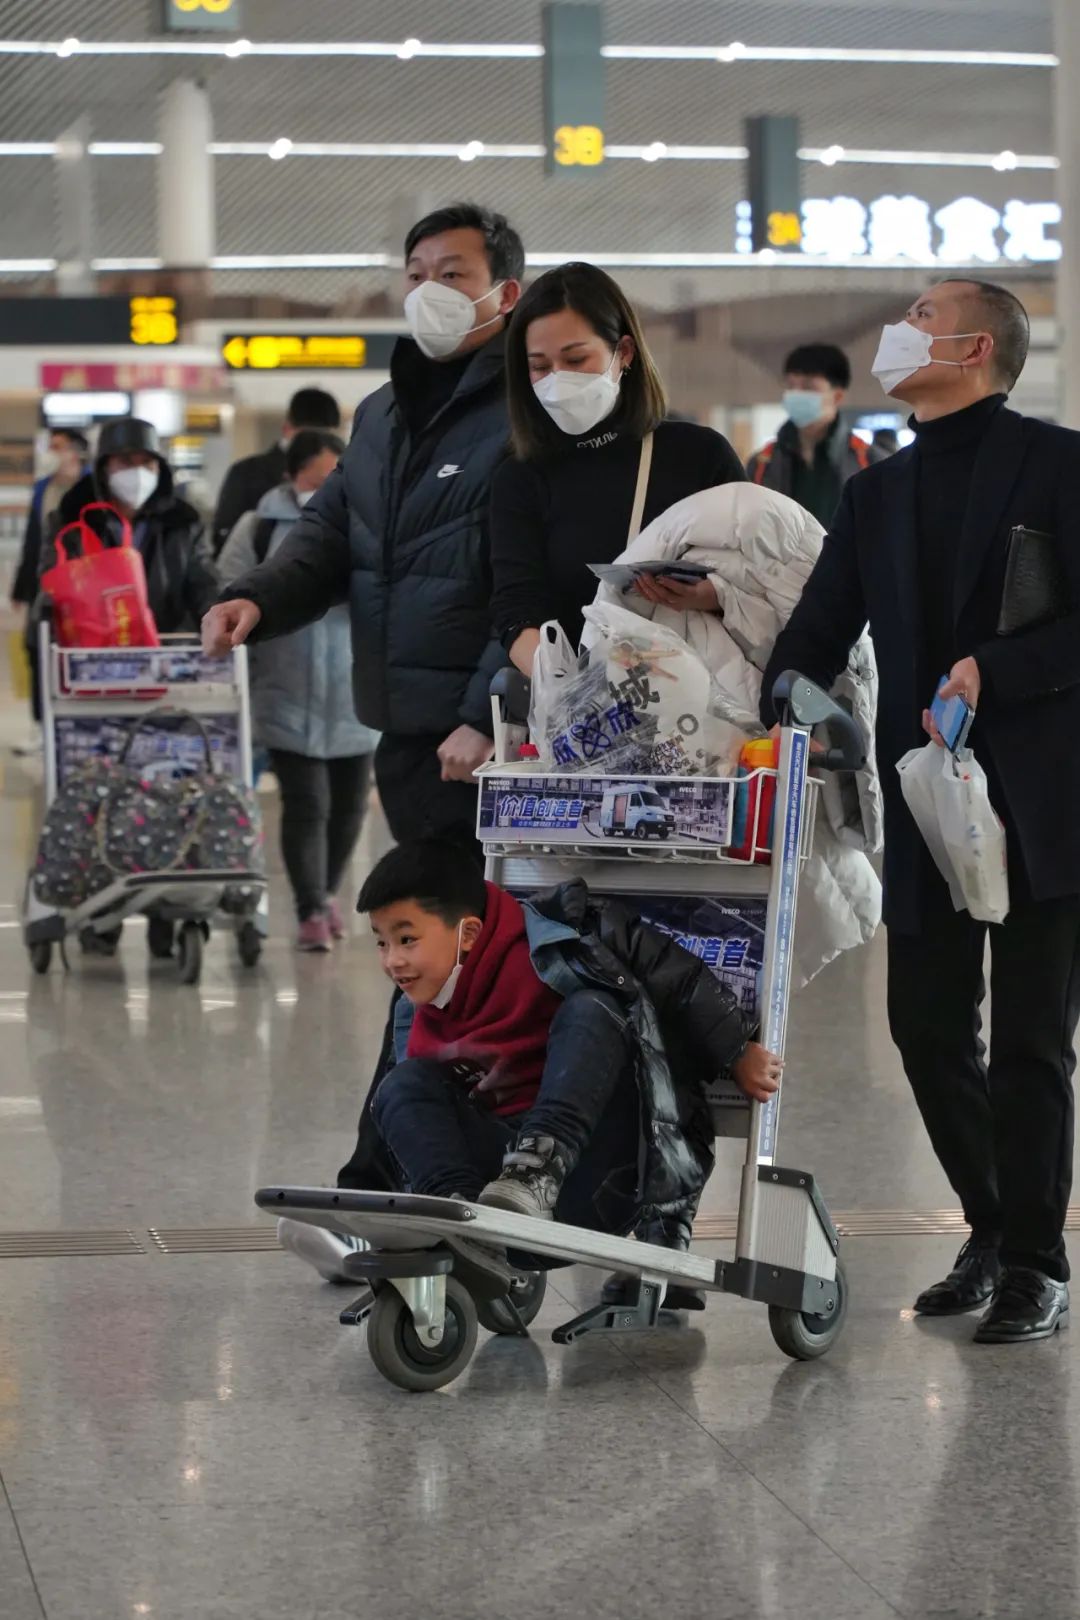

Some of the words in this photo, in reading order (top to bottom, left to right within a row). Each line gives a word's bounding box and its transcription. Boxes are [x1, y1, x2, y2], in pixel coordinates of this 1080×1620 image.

[499, 795, 584, 819] 价值创造者
